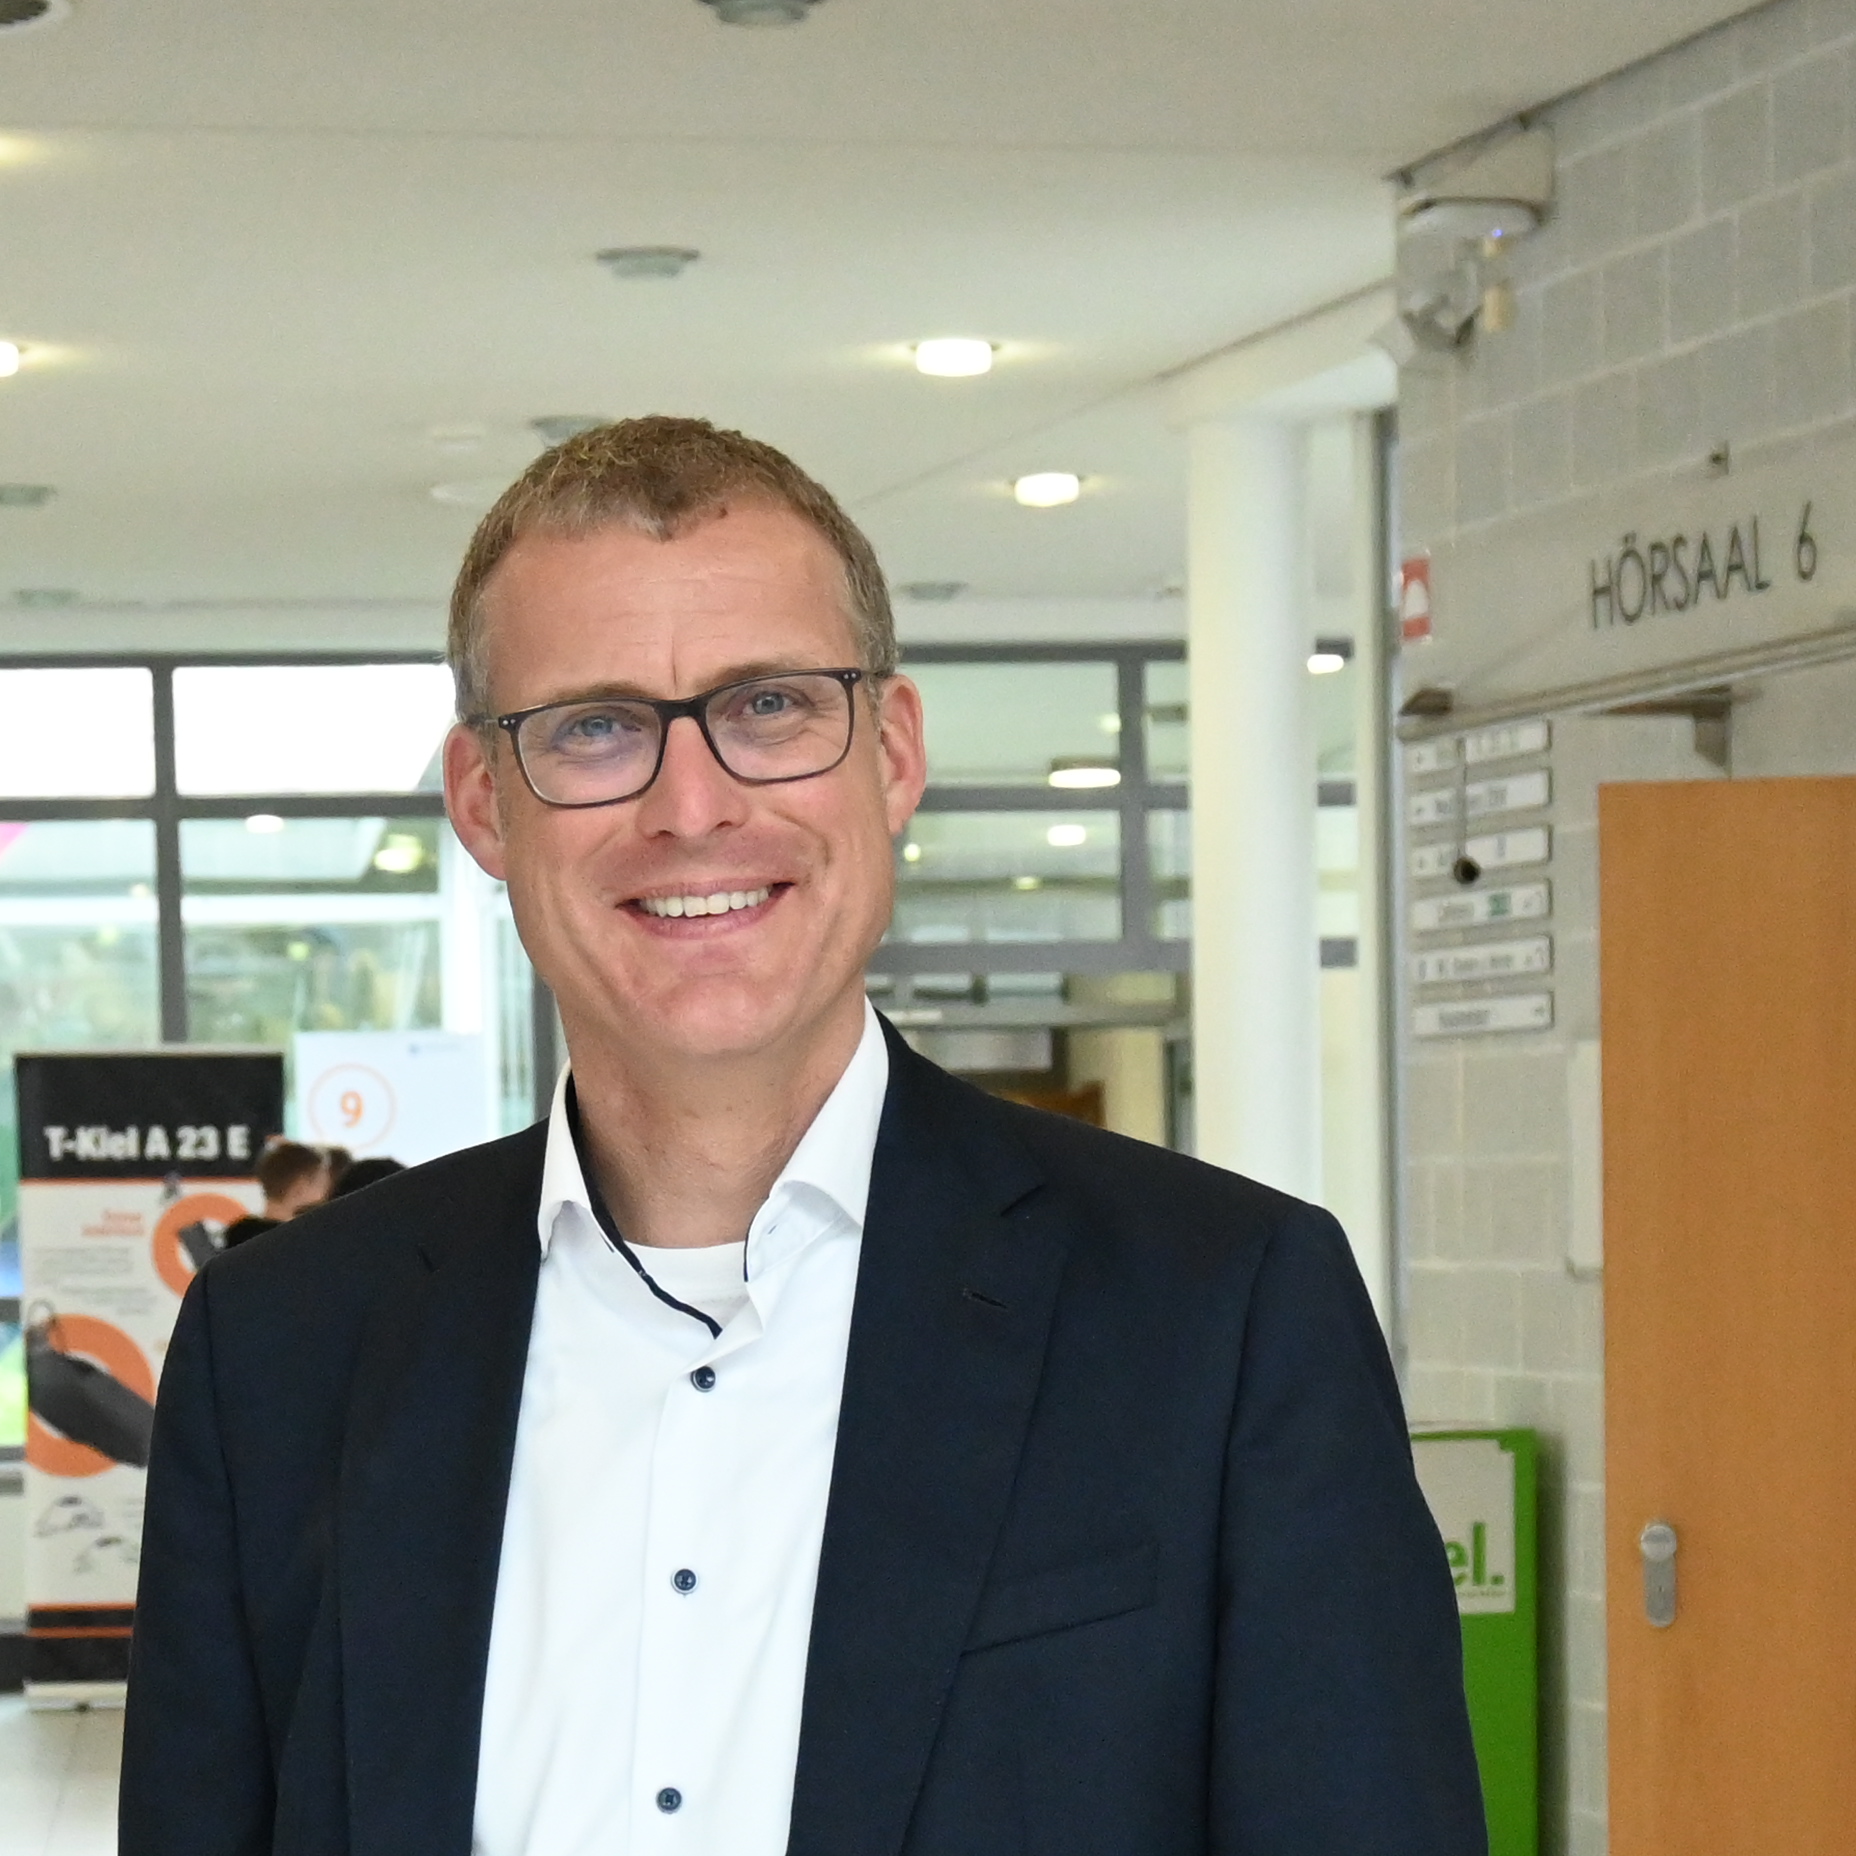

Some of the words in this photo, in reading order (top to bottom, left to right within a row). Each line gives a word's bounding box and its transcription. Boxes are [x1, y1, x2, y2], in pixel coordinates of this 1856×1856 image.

[1590, 514, 1772, 631] HÖRSAAL
[1797, 501, 1818, 582] 6
[339, 1090, 364, 1128] 9
[43, 1124, 140, 1161] T-Kiel
[144, 1124, 172, 1161] A
[176, 1124, 220, 1161] 23
[226, 1123, 251, 1161] E
